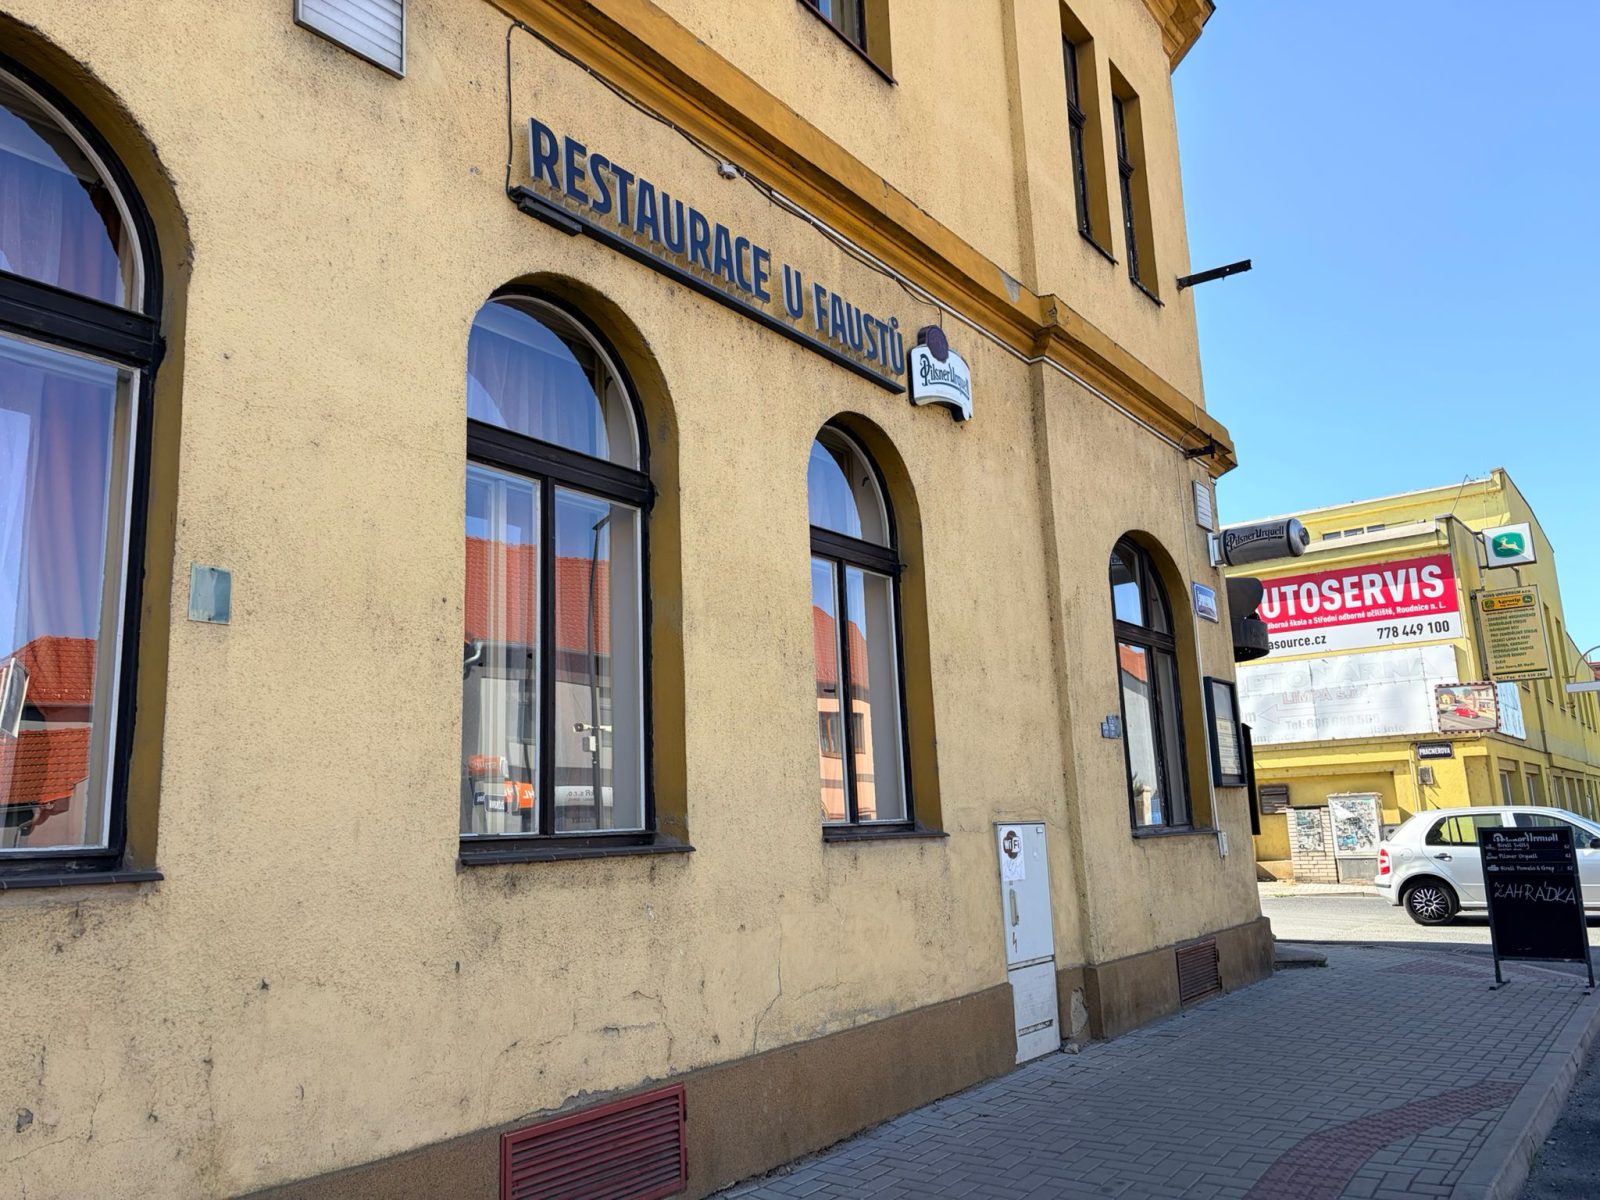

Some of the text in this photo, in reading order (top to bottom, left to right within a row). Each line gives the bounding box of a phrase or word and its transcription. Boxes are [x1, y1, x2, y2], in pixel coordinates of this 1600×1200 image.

[528, 117, 906, 375] RESTAURACE U FAUSTŮ
[920, 353, 950, 386] Pilsner
[1226, 526, 1285, 552] Pilsner Urquell
[1257, 565, 1445, 618] UTOSERVIS
[1338, 611, 1366, 621] odborné
[1396, 604, 1429, 614] Roudnice
[1268, 635, 1327, 650] asource.cz
[1377, 620, 1450, 639] 778 449 100
